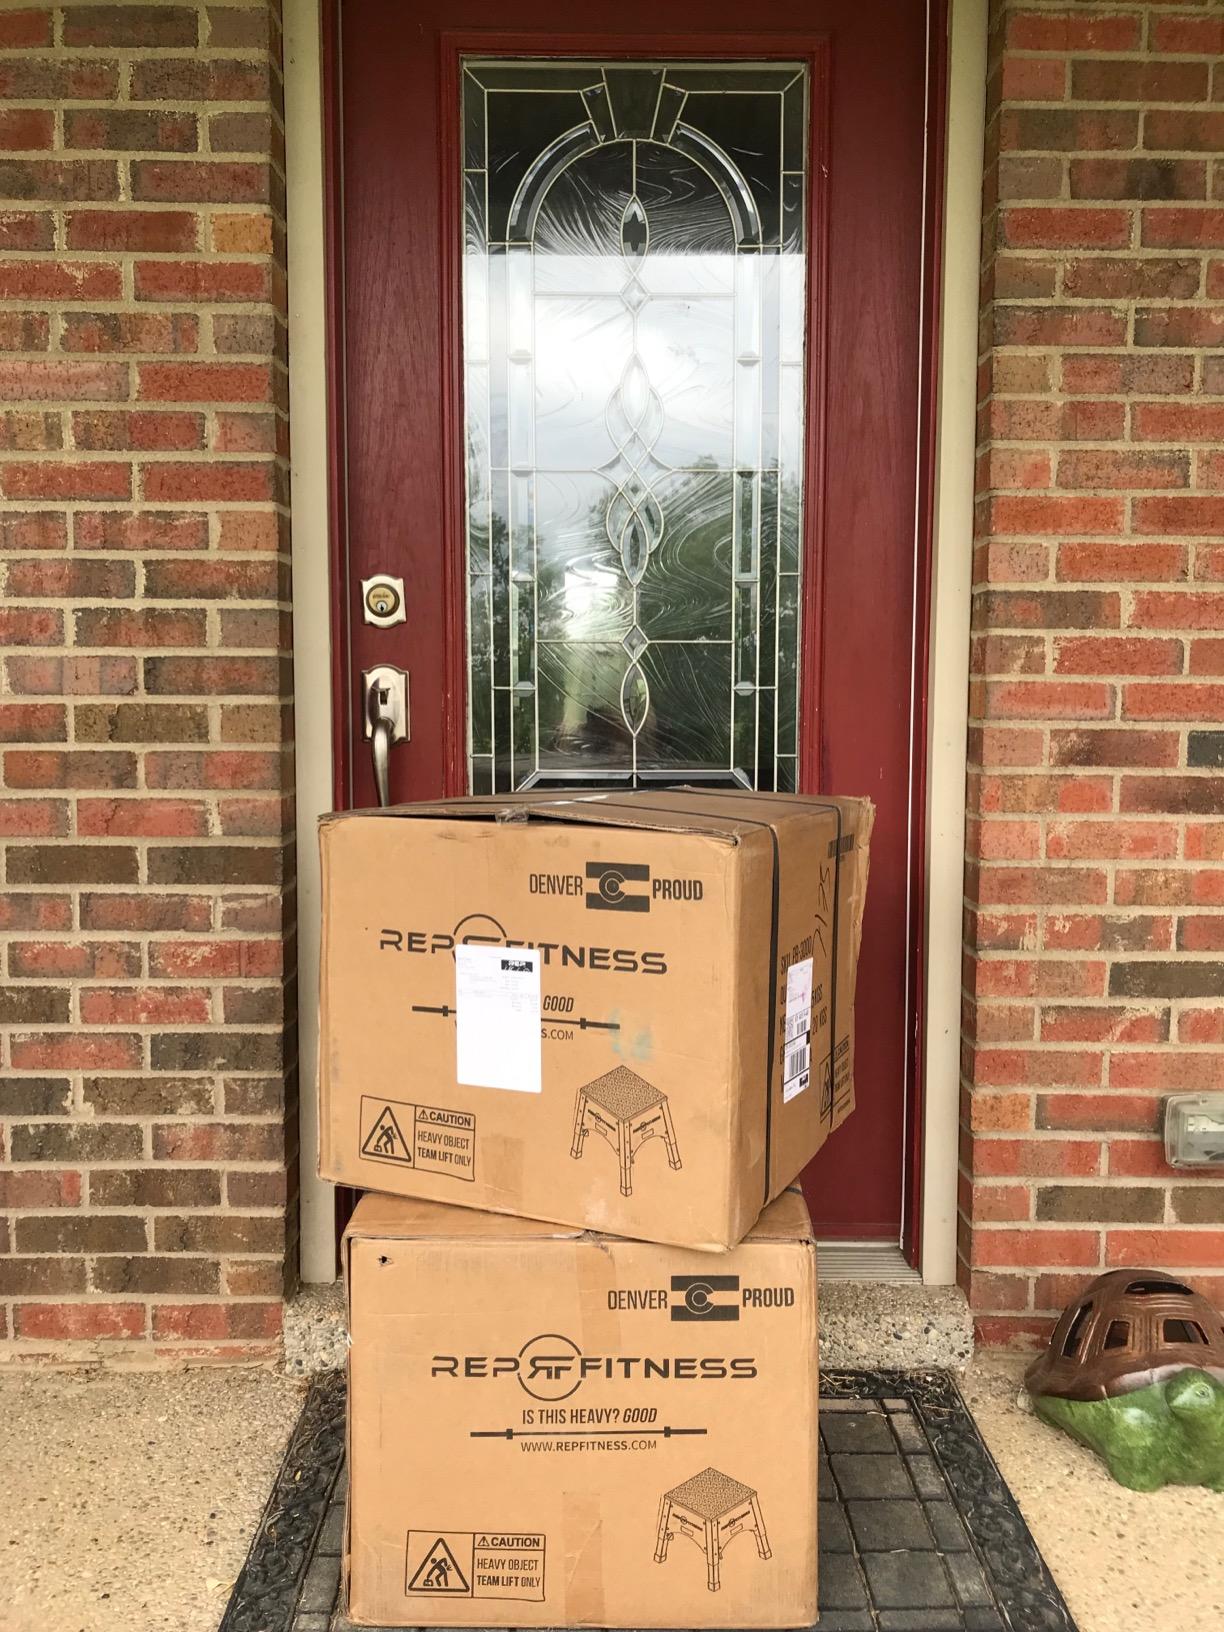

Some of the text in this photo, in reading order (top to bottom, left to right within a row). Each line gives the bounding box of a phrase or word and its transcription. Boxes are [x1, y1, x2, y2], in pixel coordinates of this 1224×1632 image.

[529, 873, 703, 901] DENVER PROUD
[380, 929, 455, 954] REP
[543, 995, 575, 1012] GOOD
[429, 1111, 471, 1127] CAUTION
[417, 1130, 470, 1150] HEAVY OBJECT
[417, 1147, 472, 1167] TEAM LIFT ONLY
[608, 1288, 795, 1310] DENVER PROUD
[431, 1356, 520, 1378] REP
[580, 1358, 758, 1379] FITNESS
[522, 1407, 658, 1425] IS THIS HEAVY? GOOD
[520, 1439, 657, 1453] WWW.REPFITNESS.COM
[491, 1537, 540, 1548] CAUTION
[477, 1558, 540, 1571] HEAVY OBJECT
[476, 1575, 540, 1588] TEAM LIFT ONLY
